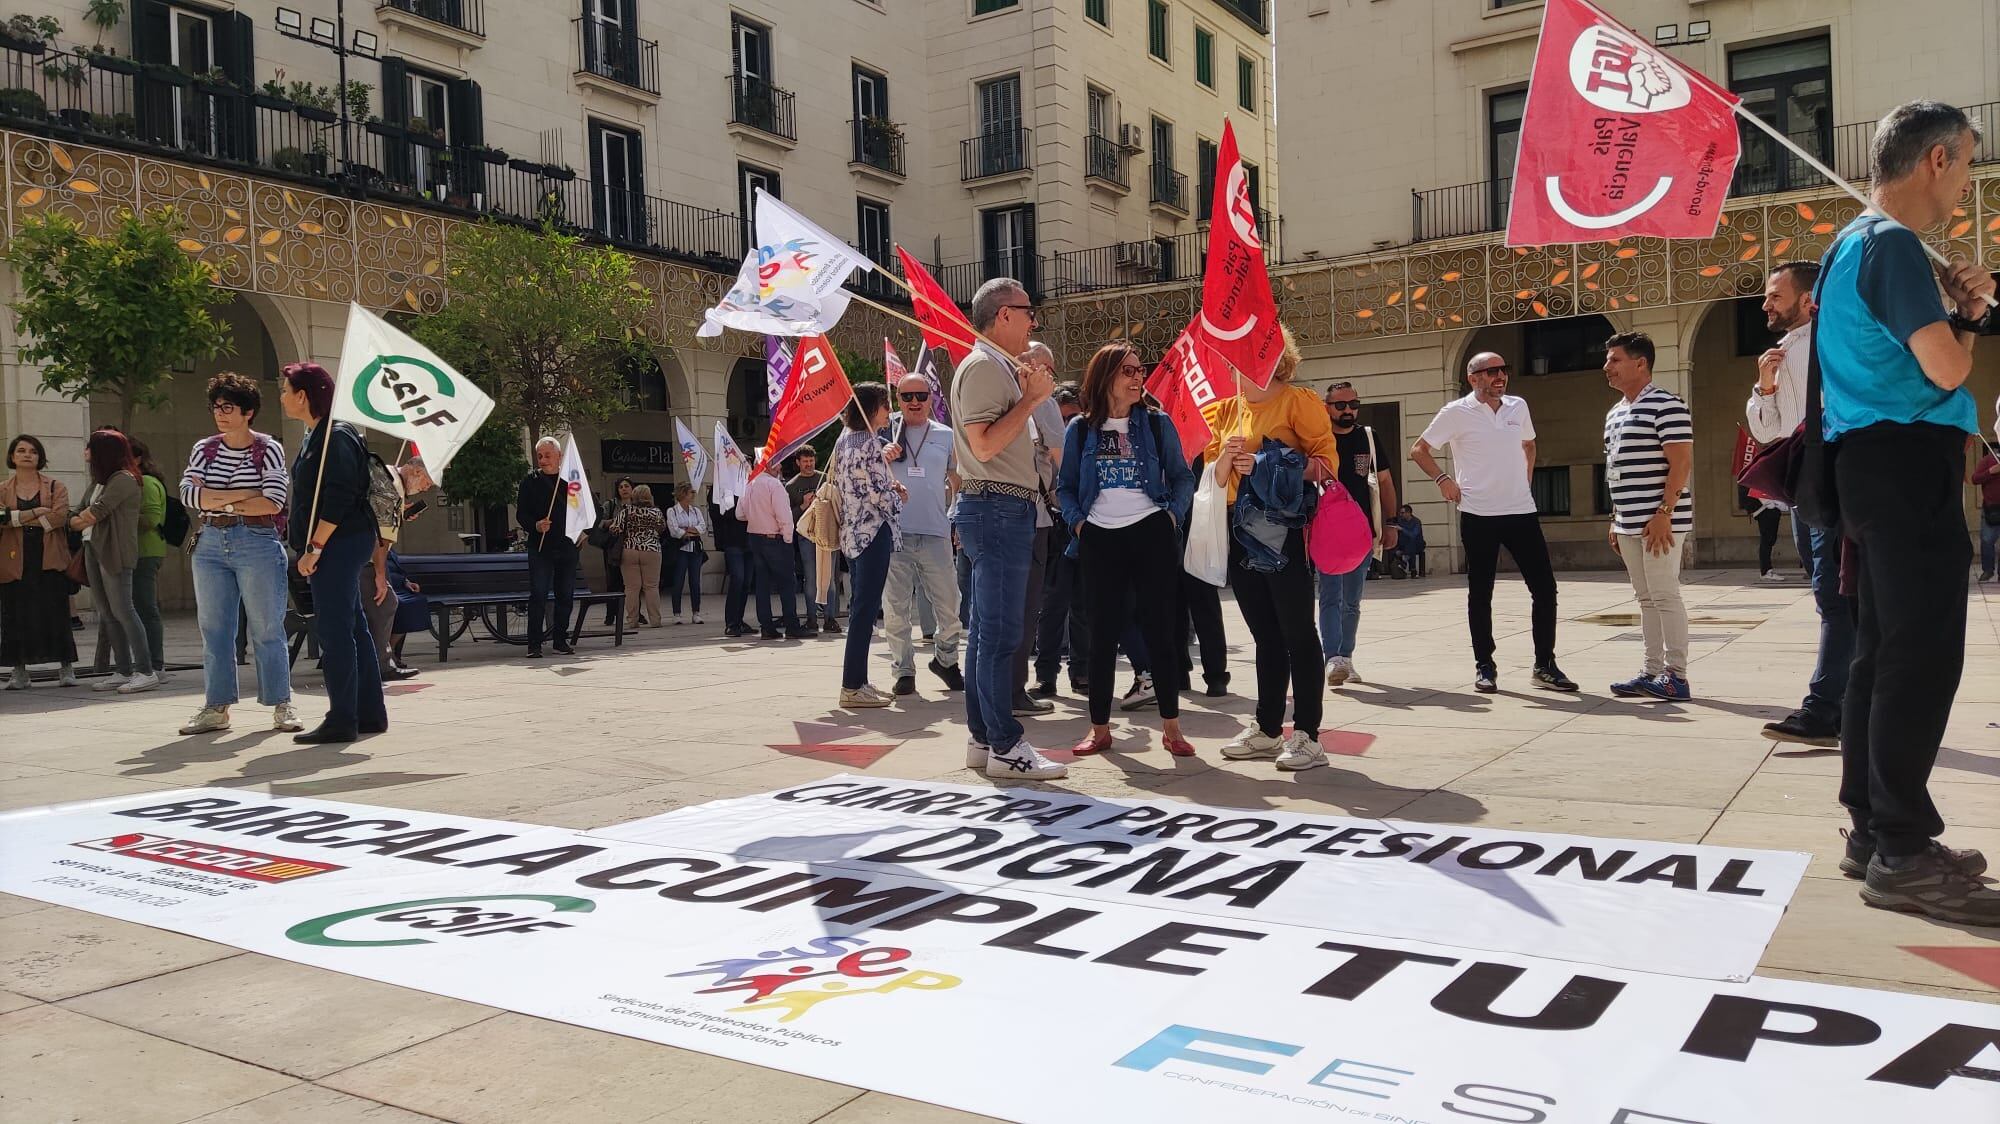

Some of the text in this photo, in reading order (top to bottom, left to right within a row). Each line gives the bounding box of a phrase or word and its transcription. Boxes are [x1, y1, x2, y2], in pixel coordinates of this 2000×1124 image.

[133, 843, 275, 870] CCOO
[773, 783, 1767, 897] CARRERA PROFESIONAL
[857, 826, 1306, 909] DIGNA
[110, 797, 605, 884] BARCALA
[575, 857, 1269, 976] CUMPLE
[1301, 940, 1628, 1031] TU
[598, 993, 843, 1047] Sindicato de Empleados Públicos
[610, 1006, 789, 1048] Comunidad Valenciana
[1163, 1071, 1348, 1112] CONFEDERACIÓN
